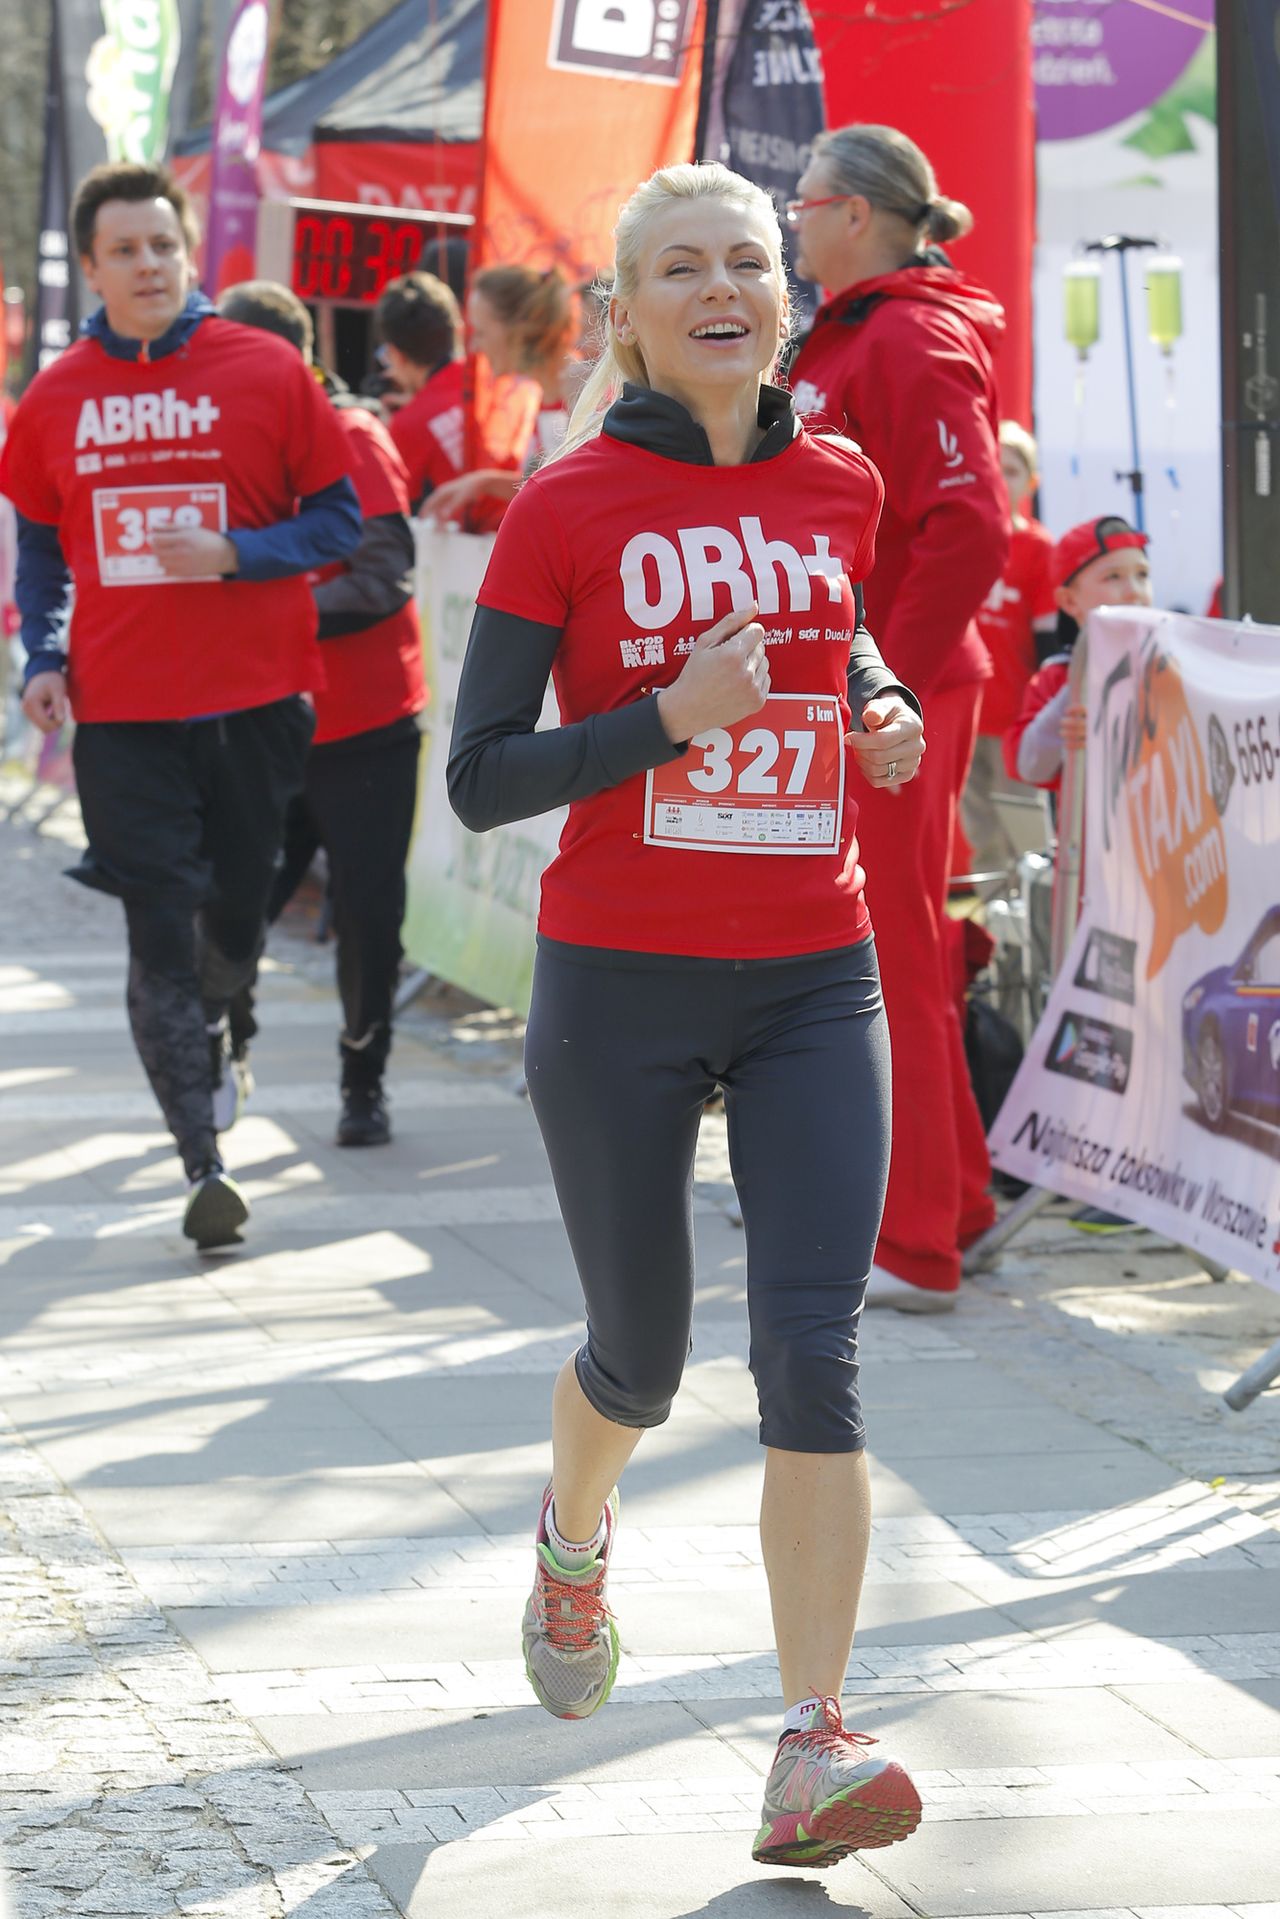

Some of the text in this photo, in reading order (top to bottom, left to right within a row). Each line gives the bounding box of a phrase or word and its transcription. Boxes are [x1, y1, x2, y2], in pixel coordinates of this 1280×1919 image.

[75, 388, 220, 449] ABRh+
[619, 516, 848, 629] ORh+
[619, 635, 664, 649] BLOOD
[622, 649, 665, 668] RUN
[806, 705, 834, 722] 5 km
[687, 728, 816, 794] 327
[1234, 714, 1280, 787] 666-
[1129, 714, 1204, 880] TAXI
[1184, 826, 1226, 908] .com
